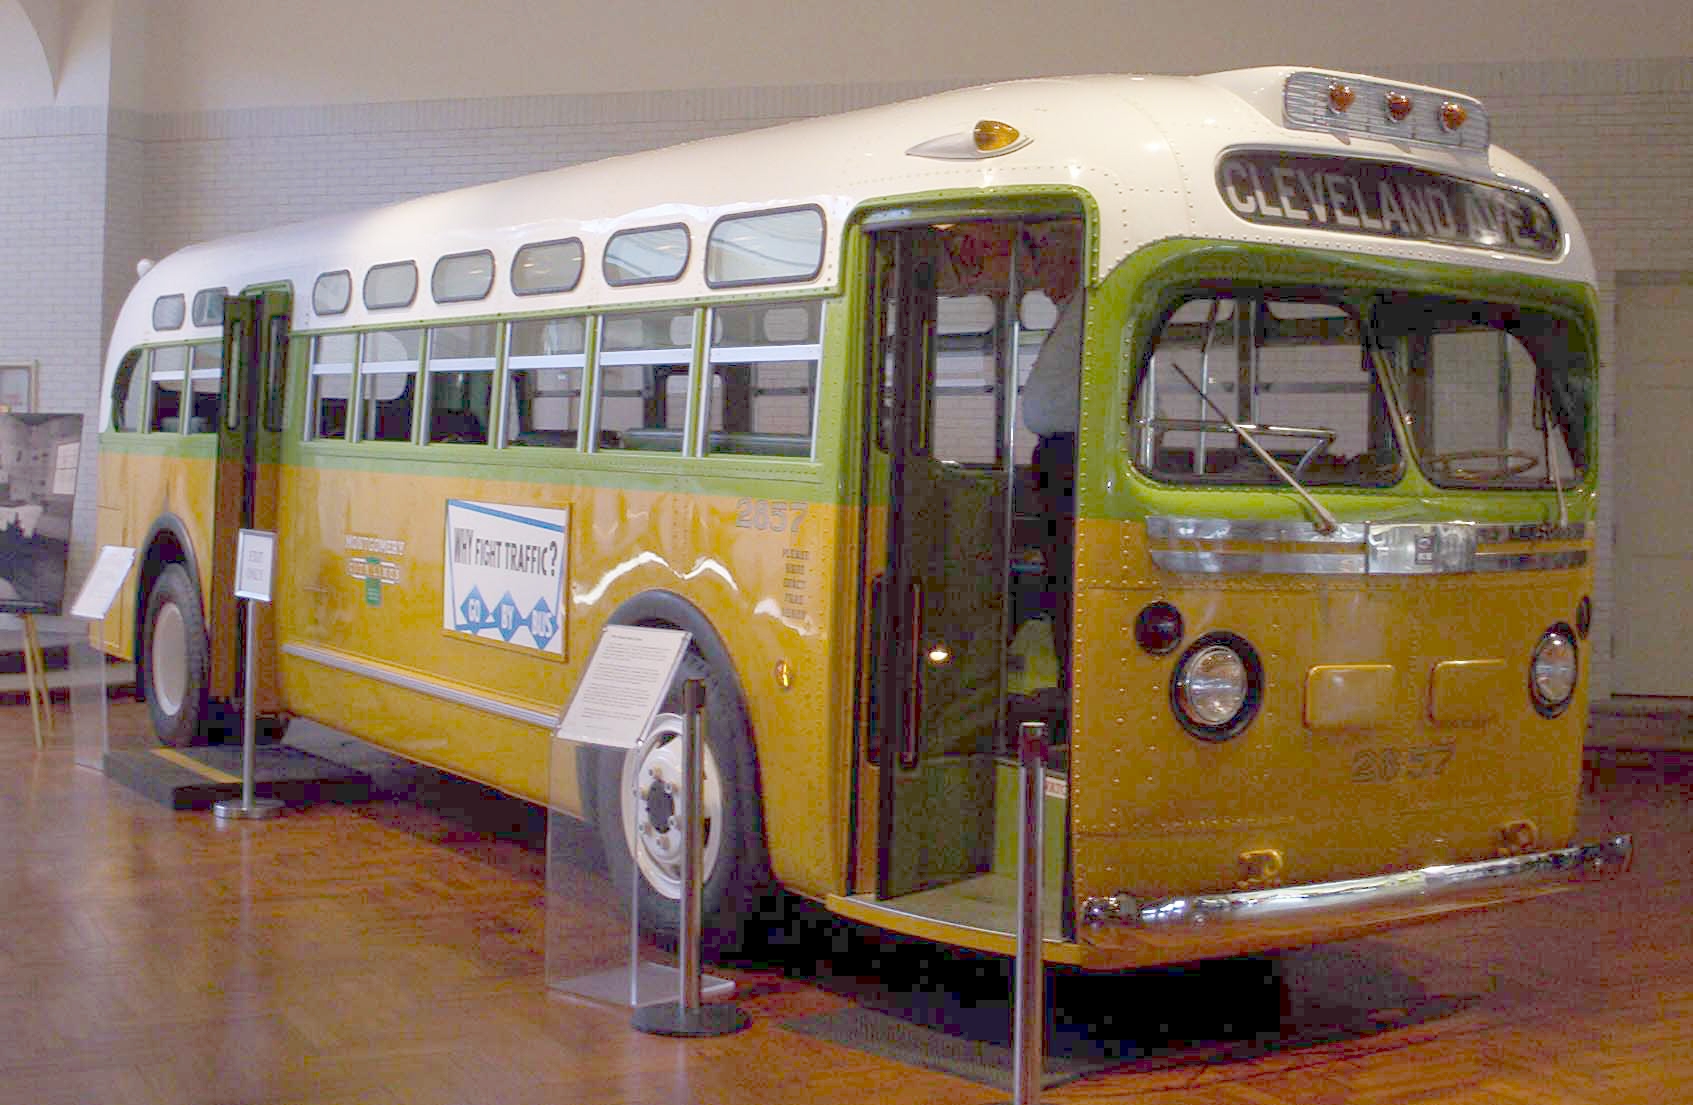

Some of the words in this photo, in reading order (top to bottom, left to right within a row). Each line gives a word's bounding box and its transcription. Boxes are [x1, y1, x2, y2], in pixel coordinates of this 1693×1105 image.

[1223, 159, 1456, 238] CLEVELAND
[735, 496, 809, 533] 2857
[454, 528, 474, 564] WHY
[475, 538, 502, 568] FIGHT
[504, 540, 558, 577] TRAFFIC?
[532, 610, 553, 637] BUS
[1351, 743, 1456, 784] 2857
